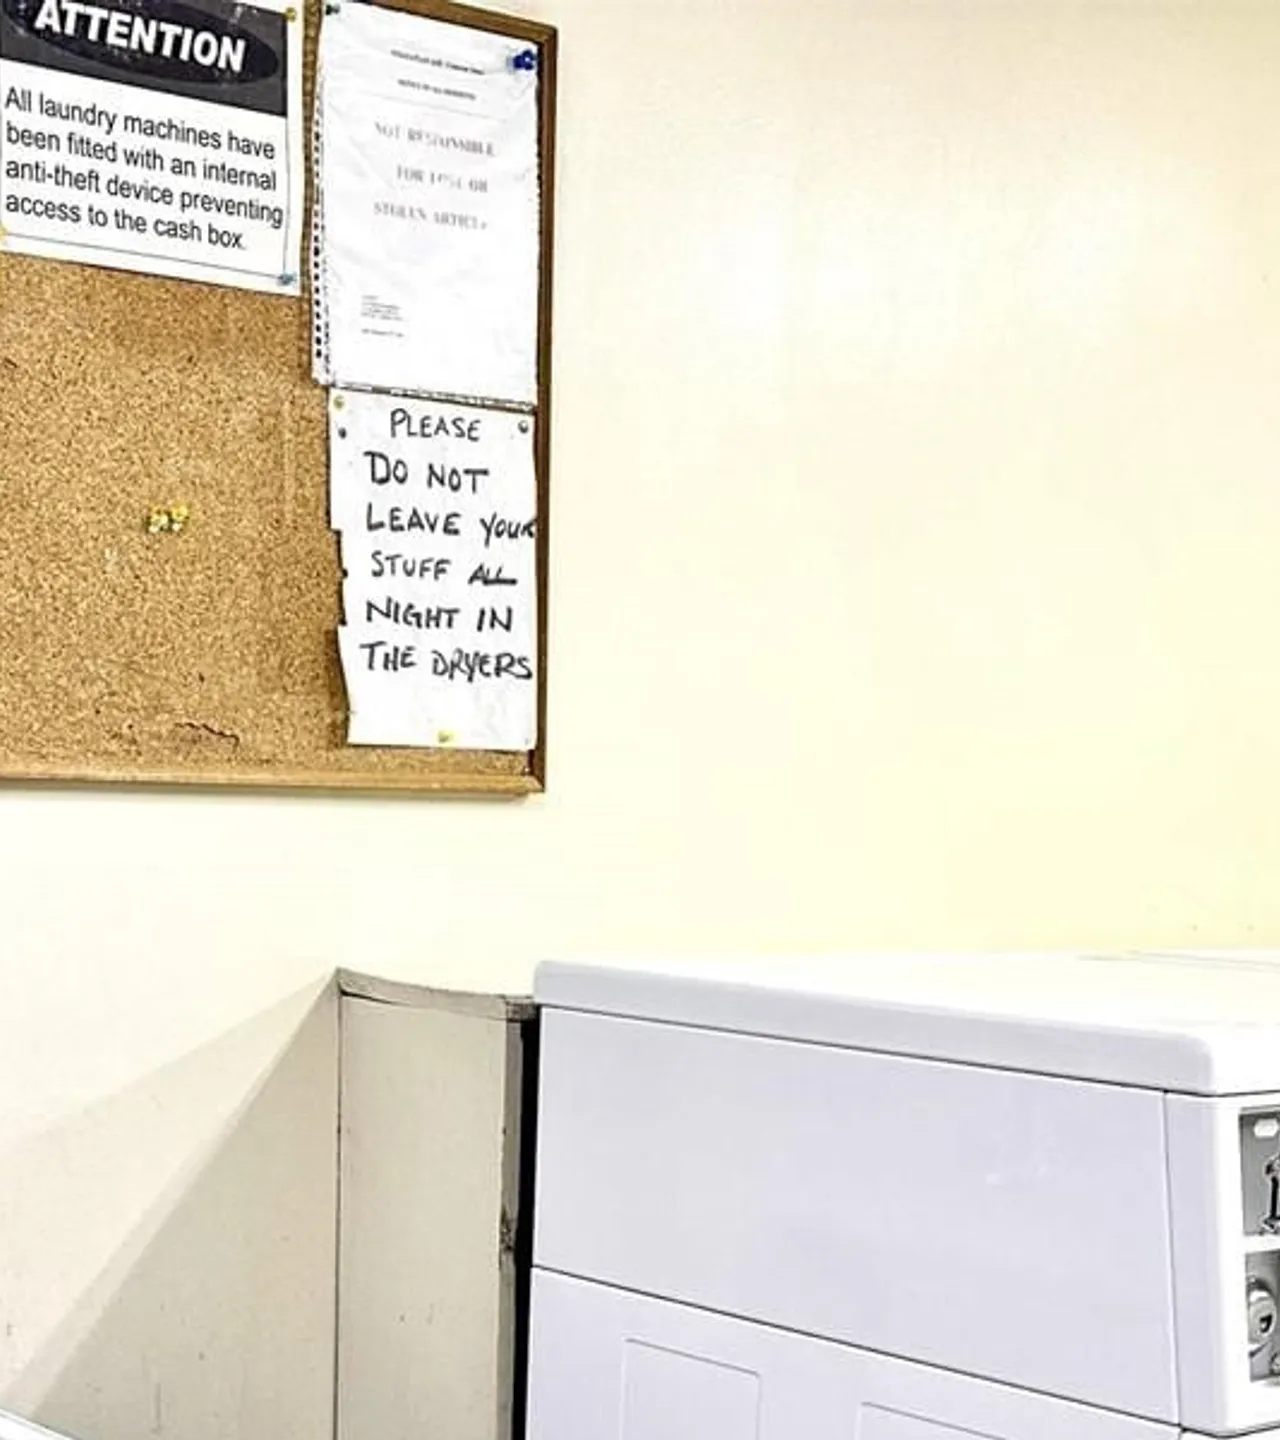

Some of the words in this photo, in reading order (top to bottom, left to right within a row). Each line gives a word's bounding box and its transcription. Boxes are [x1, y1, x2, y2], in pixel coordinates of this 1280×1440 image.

[34, 0, 246, 72] ATTENTION
[4, 86, 32, 113] All
[39, 91, 117, 135] laundry
[123, 114, 222, 150] machines
[227, 130, 276, 160] have
[375, 121, 401, 140] NOT
[6, 121, 60, 151] been
[67, 132, 117, 163] fitted
[124, 145, 164, 172] with
[170, 157, 196, 178] an
[202, 158, 277, 191] internal
[6, 159, 100, 194] anti-theft
[106, 175, 173, 205] device
[179, 190, 283, 229] preventing
[6, 194, 81, 223] access
[87, 204, 108, 226] to
[114, 209, 147, 233] the
[153, 216, 203, 241] cash
[208, 224, 247, 250] box.
[390, 408, 481, 441] PLEASE
[363, 451, 408, 485] DO
[427, 463, 489, 494] NOT
[367, 503, 461, 535] LEAVE
[480, 512, 535, 547] YOUR
[371, 551, 451, 580] STUFF
[469, 564, 517, 586] ALL
[366, 597, 460, 629] NIGHT
[477, 607, 513, 631] IN
[359, 641, 416, 671] THE
[432, 649, 533, 683] DRYERS
